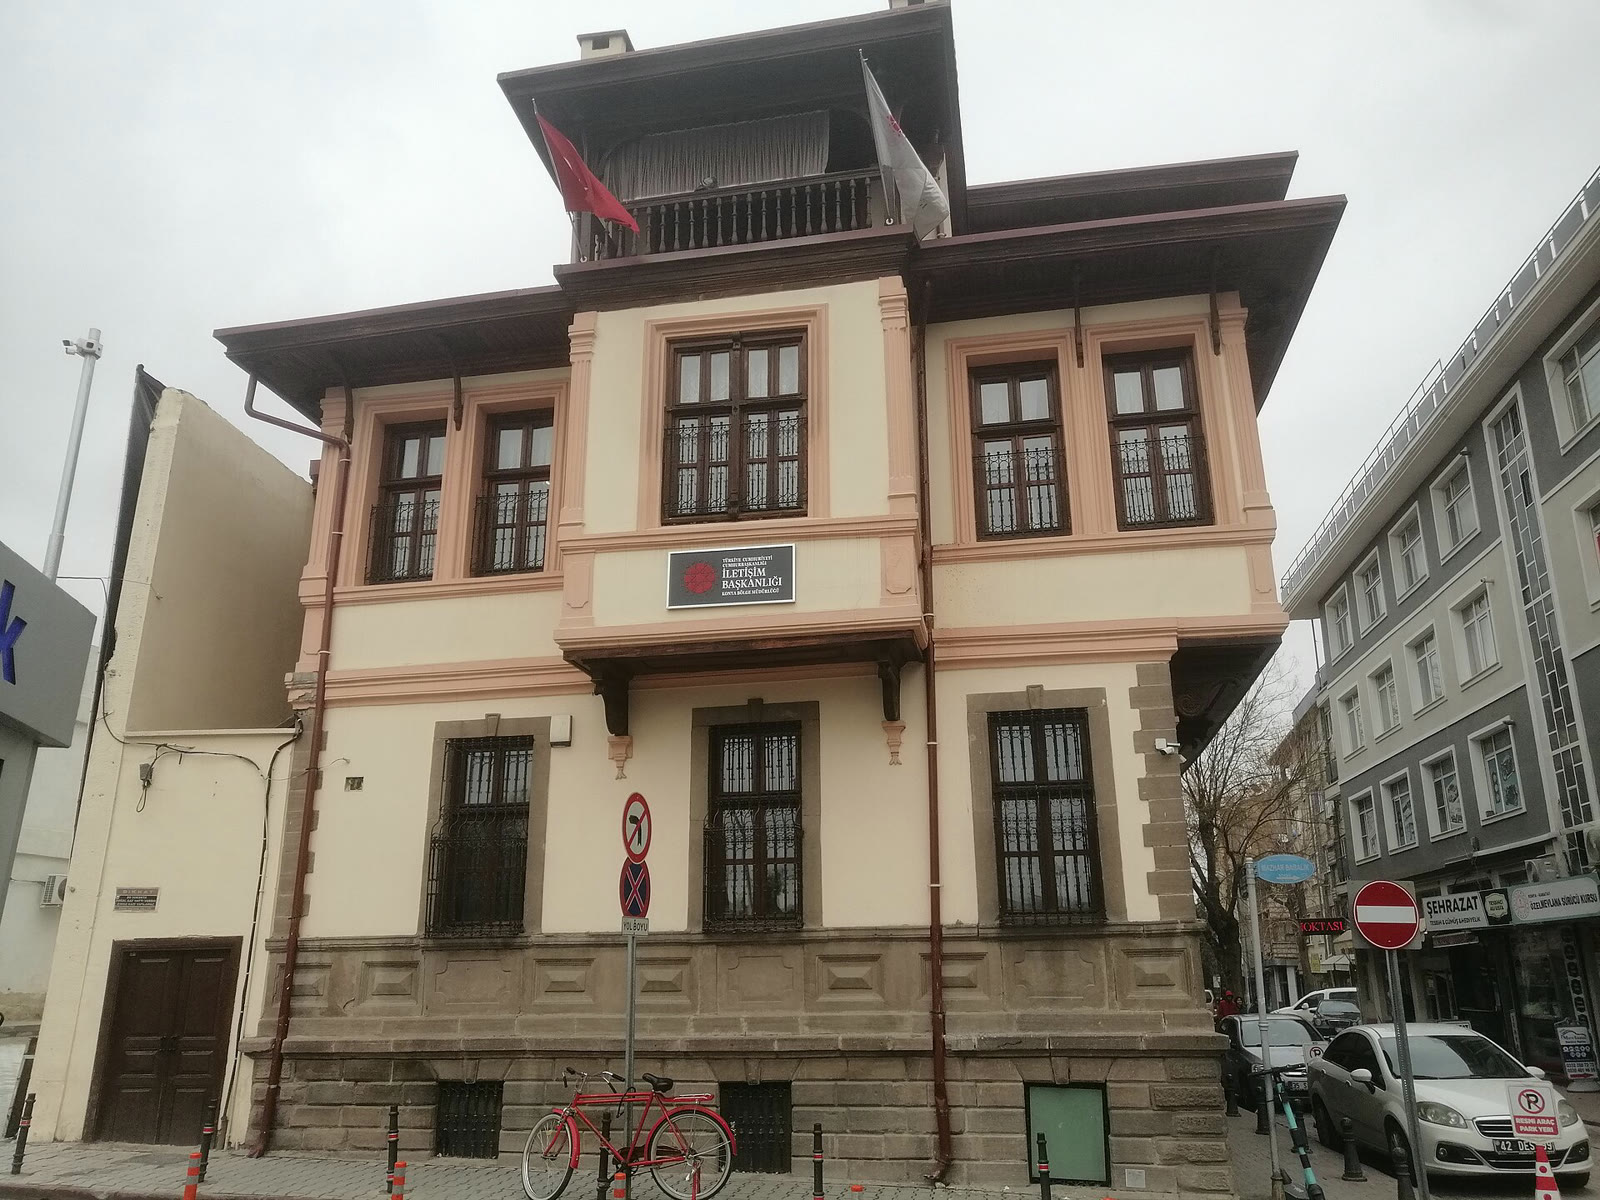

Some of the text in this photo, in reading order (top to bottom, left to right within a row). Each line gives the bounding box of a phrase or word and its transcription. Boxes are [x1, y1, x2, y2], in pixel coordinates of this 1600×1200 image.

[722, 566, 766, 578] İLETİŞİM
[722, 576, 782, 590] BAŞKANLIĞI
[1426, 896, 1478, 918] ŞEHRAZAT
[1500, 1141, 1512, 1150] 42
[1518, 1141, 1535, 1150] DES
